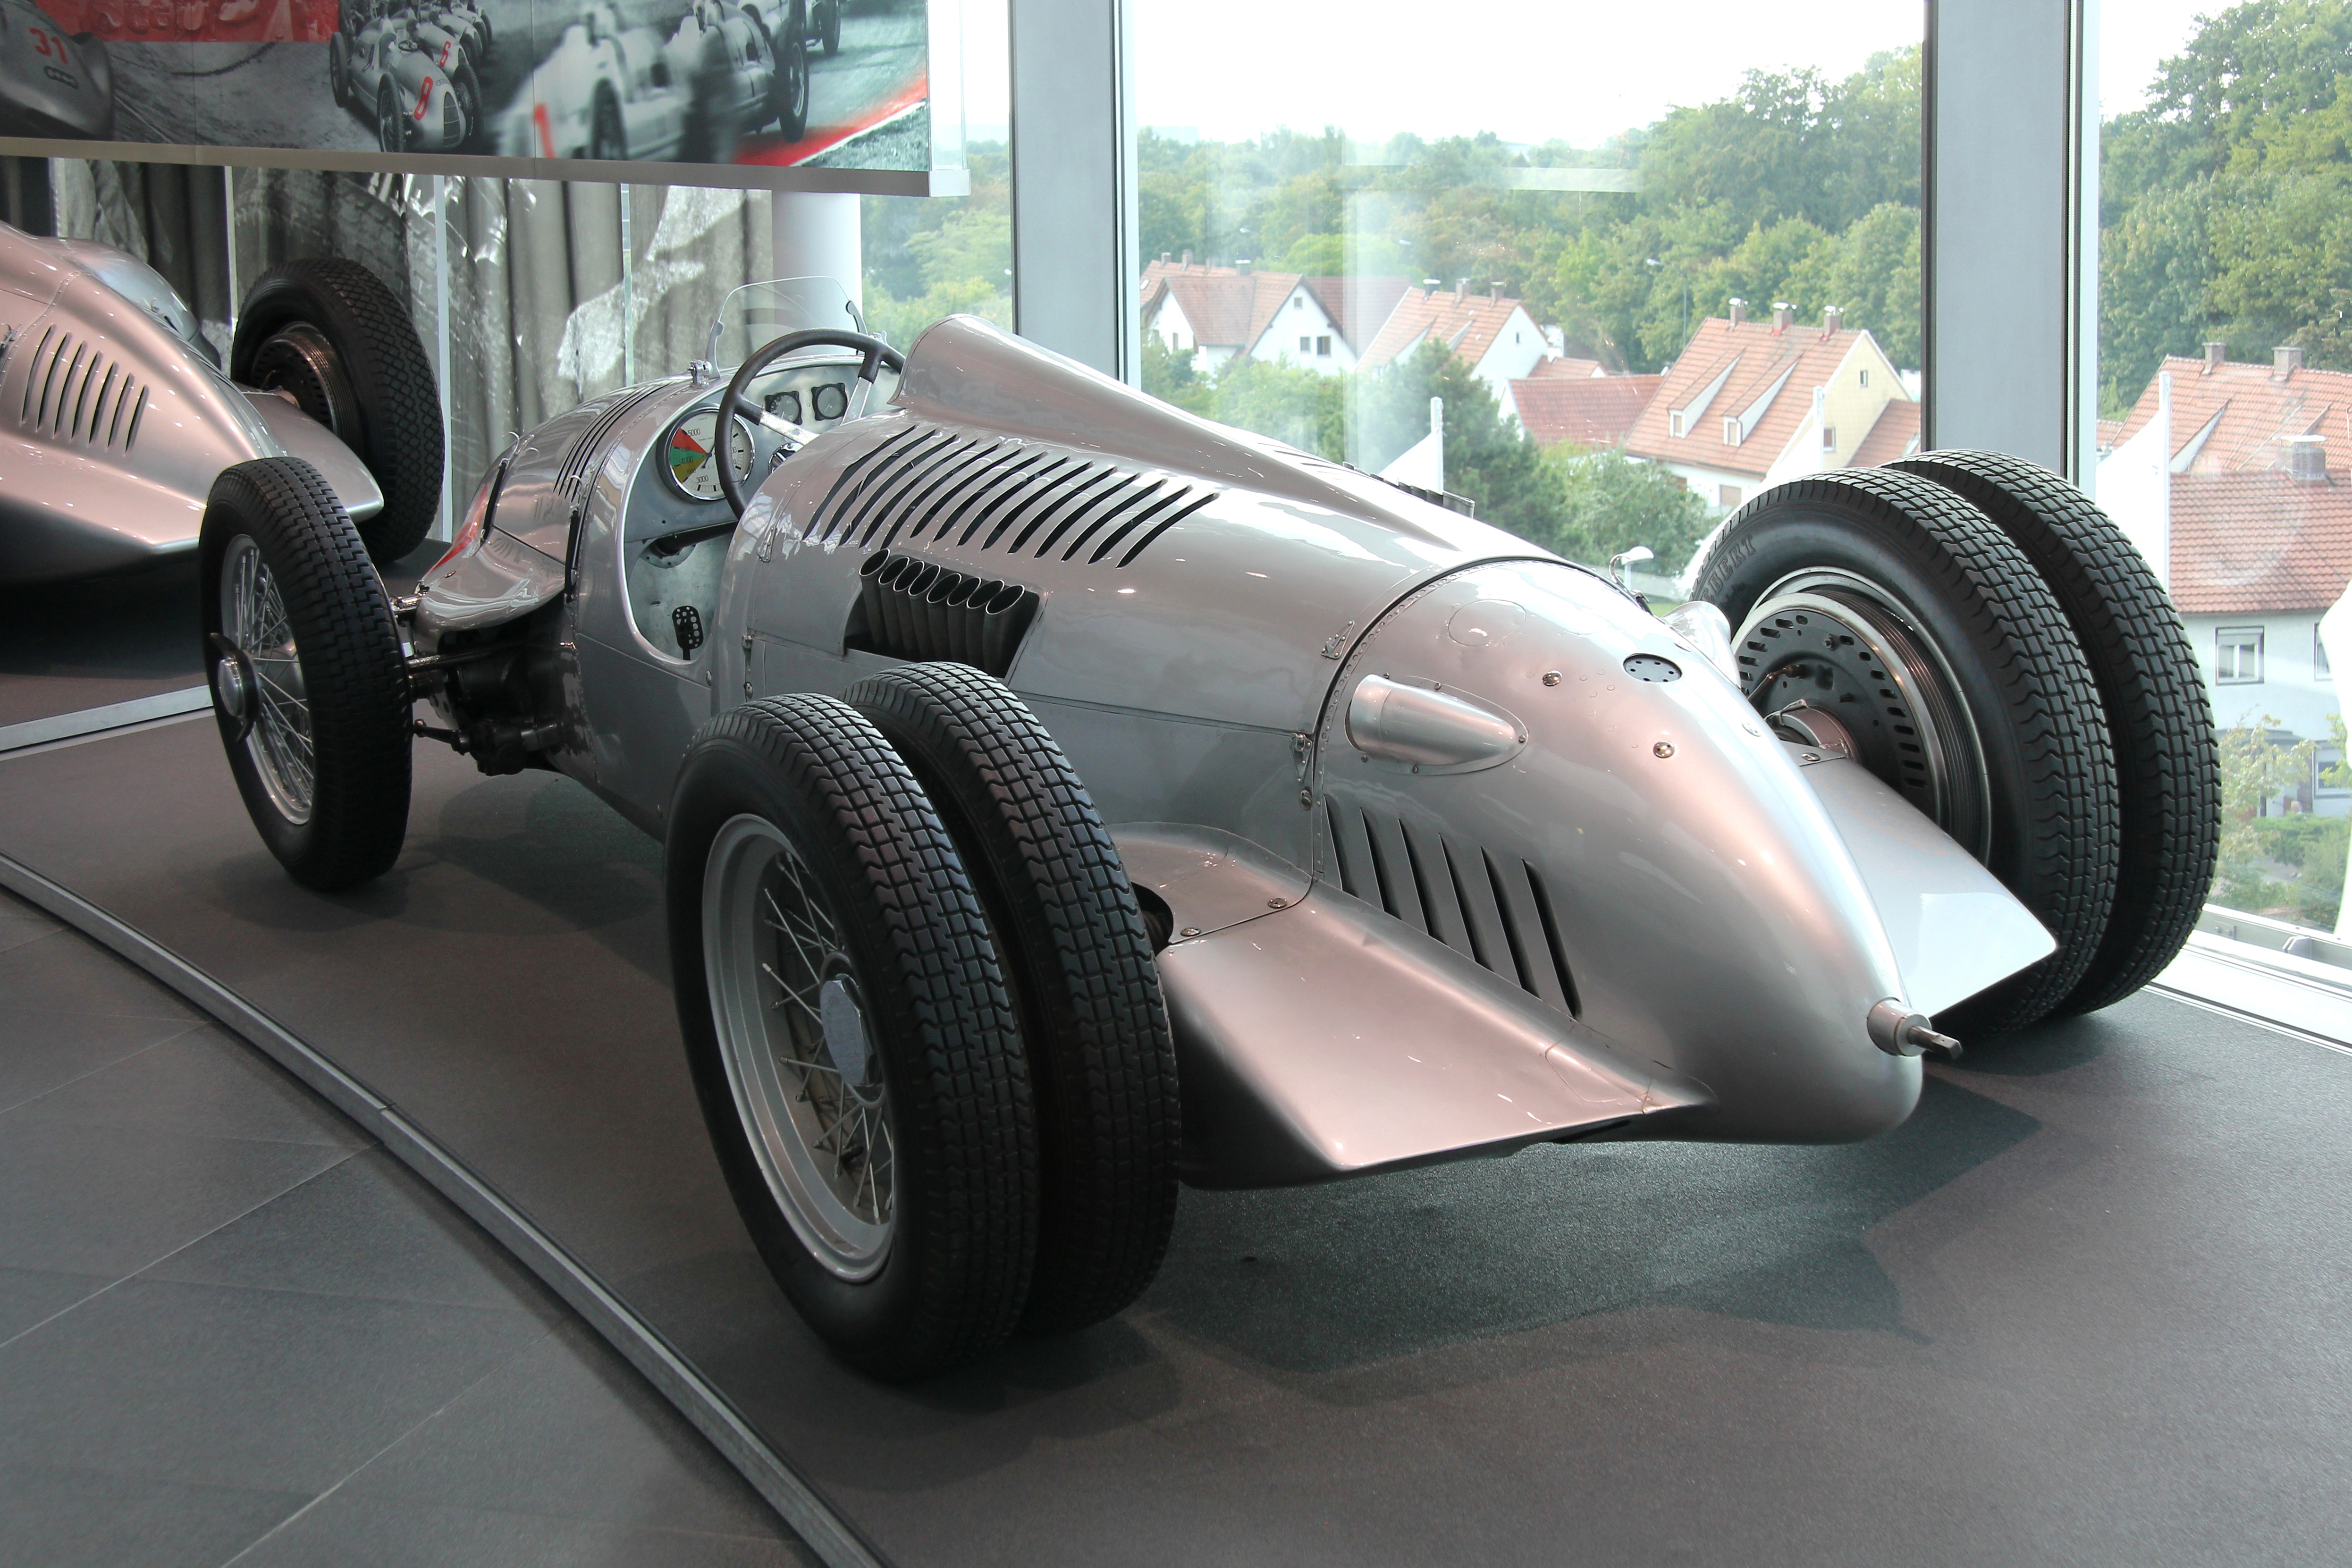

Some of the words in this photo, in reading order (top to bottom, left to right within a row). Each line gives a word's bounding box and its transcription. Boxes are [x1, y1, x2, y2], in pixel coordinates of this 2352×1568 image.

[29, 27, 69, 65] 31
[439, 41, 451, 67] 6
[414, 76, 433, 120] 8
[688, 428, 700, 437] 5000
[696, 475, 709, 483] 3000
